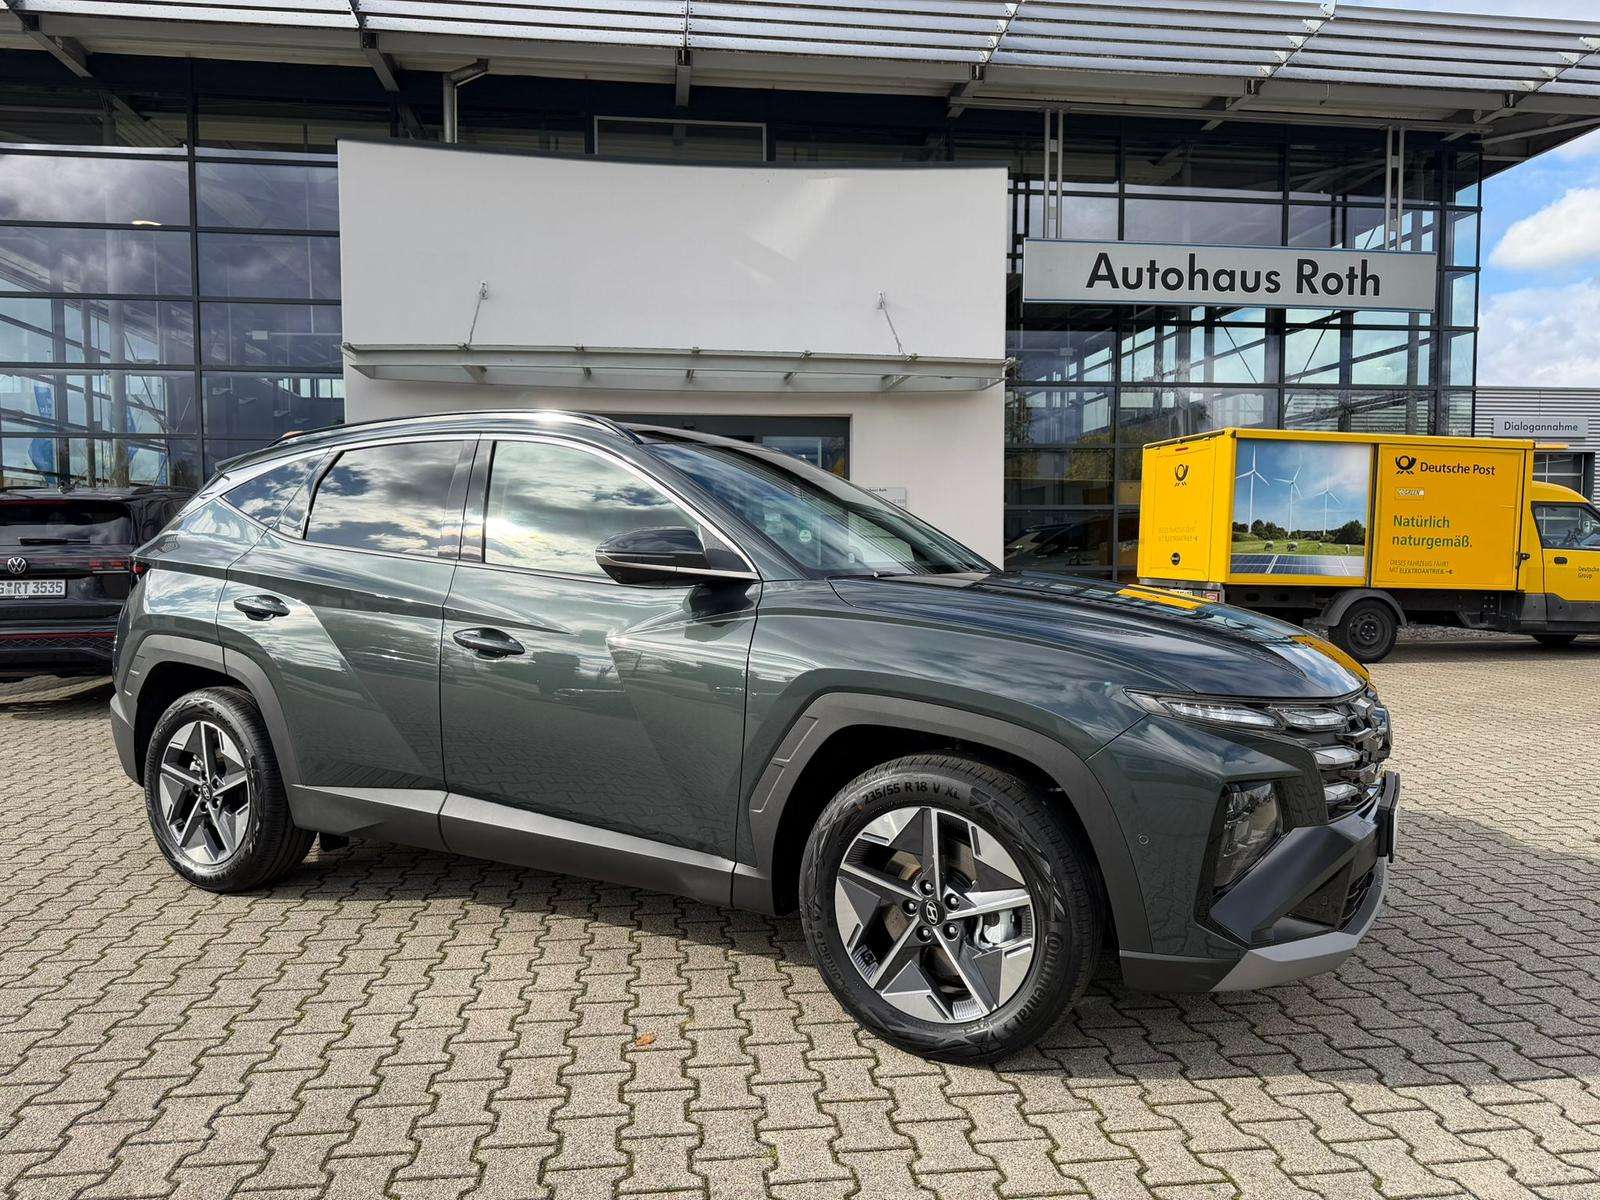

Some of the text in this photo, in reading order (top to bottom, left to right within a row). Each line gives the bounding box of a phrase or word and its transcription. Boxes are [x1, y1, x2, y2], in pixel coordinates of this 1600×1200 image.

[1085, 252, 1381, 296] Autohaus Roth
[1504, 421, 1578, 433] Dialogannahme
[1420, 462, 1496, 475] Deutsche Post
[1393, 515, 1450, 528] Natürlich
[1392, 535, 1473, 549] naturgemäß.
[14, 582, 29, 594] RT
[32, 582, 63, 594] 3535
[862, 783, 901, 804] 235/55
[904, 782, 913, 792] R
[915, 781, 928, 792] 18
[932, 783, 940, 794] V
